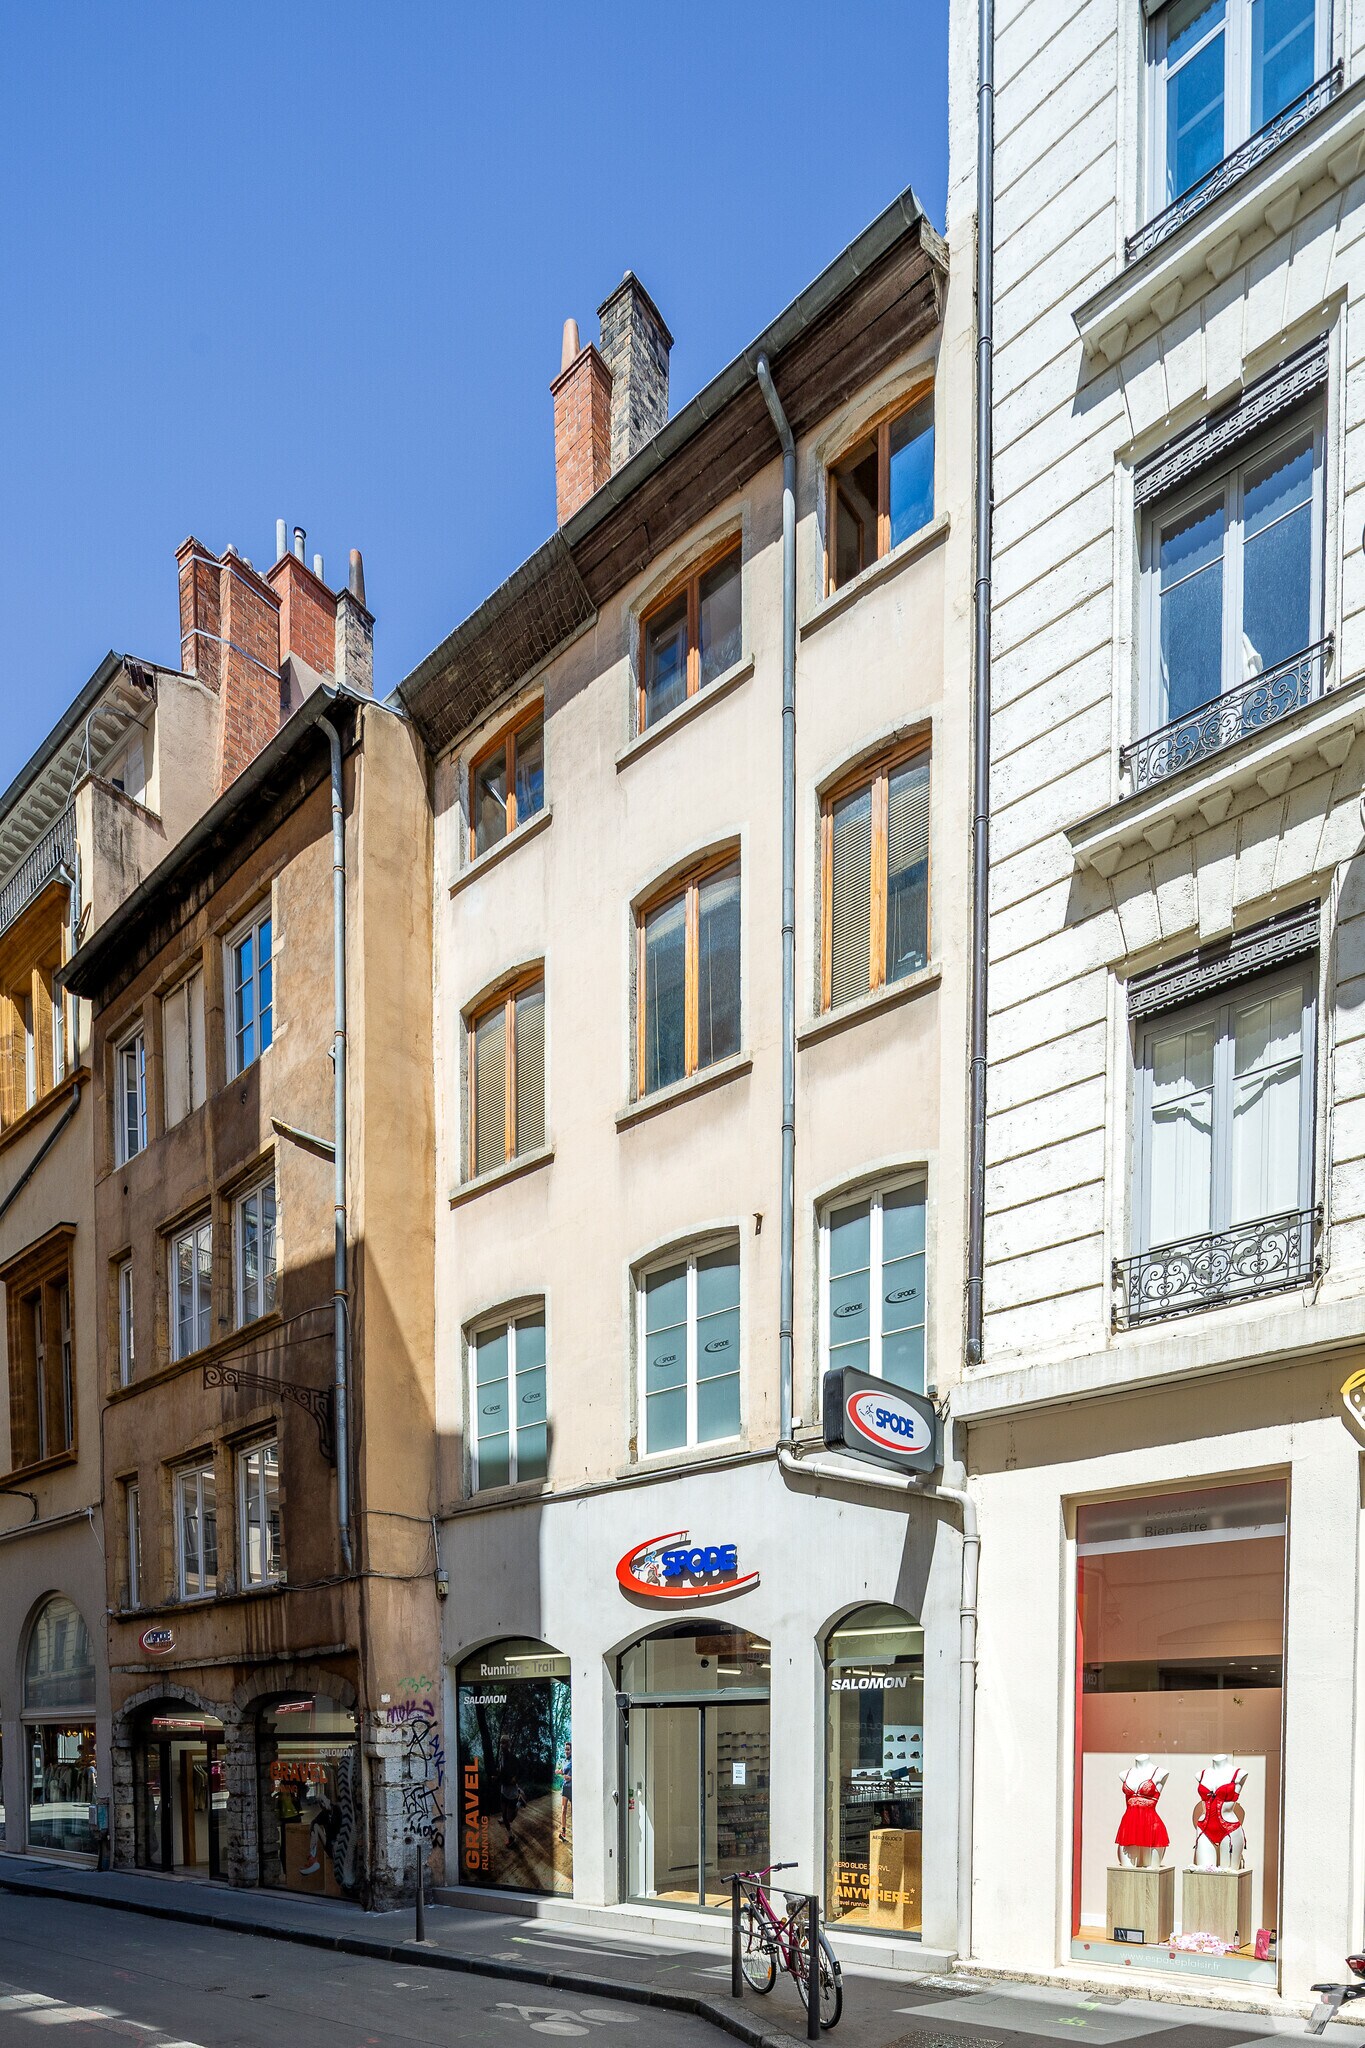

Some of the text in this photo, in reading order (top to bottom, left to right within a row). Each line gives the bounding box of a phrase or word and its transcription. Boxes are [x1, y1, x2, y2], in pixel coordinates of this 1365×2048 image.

[897, 1287, 916, 1299] SPODE
[844, 1302, 863, 1313] SPODE
[713, 1339, 729, 1349] SPODE
[661, 1354, 676, 1363] SPODE
[875, 1407, 914, 1439] SPODE
[1144, 1523, 1208, 1538] Bien-être
[661, 1543, 737, 1577] SPODE
[480, 1661, 522, 1677] Running
[532, 1658, 556, 1673] Trail
[831, 1676, 908, 1691] SALOMON
[463, 1694, 508, 1705] SALOMON
[320, 1748, 355, 1757] SALOMON
[270, 1760, 328, 1784] GRAVEL
[464, 1756, 480, 1869] GRAVEL
[481, 1815, 489, 1871] RUNNING
[833, 1861, 850, 1869] AERO
[850, 1862, 868, 1870] GLIDE
[833, 1871, 883, 1887] LET GO.
